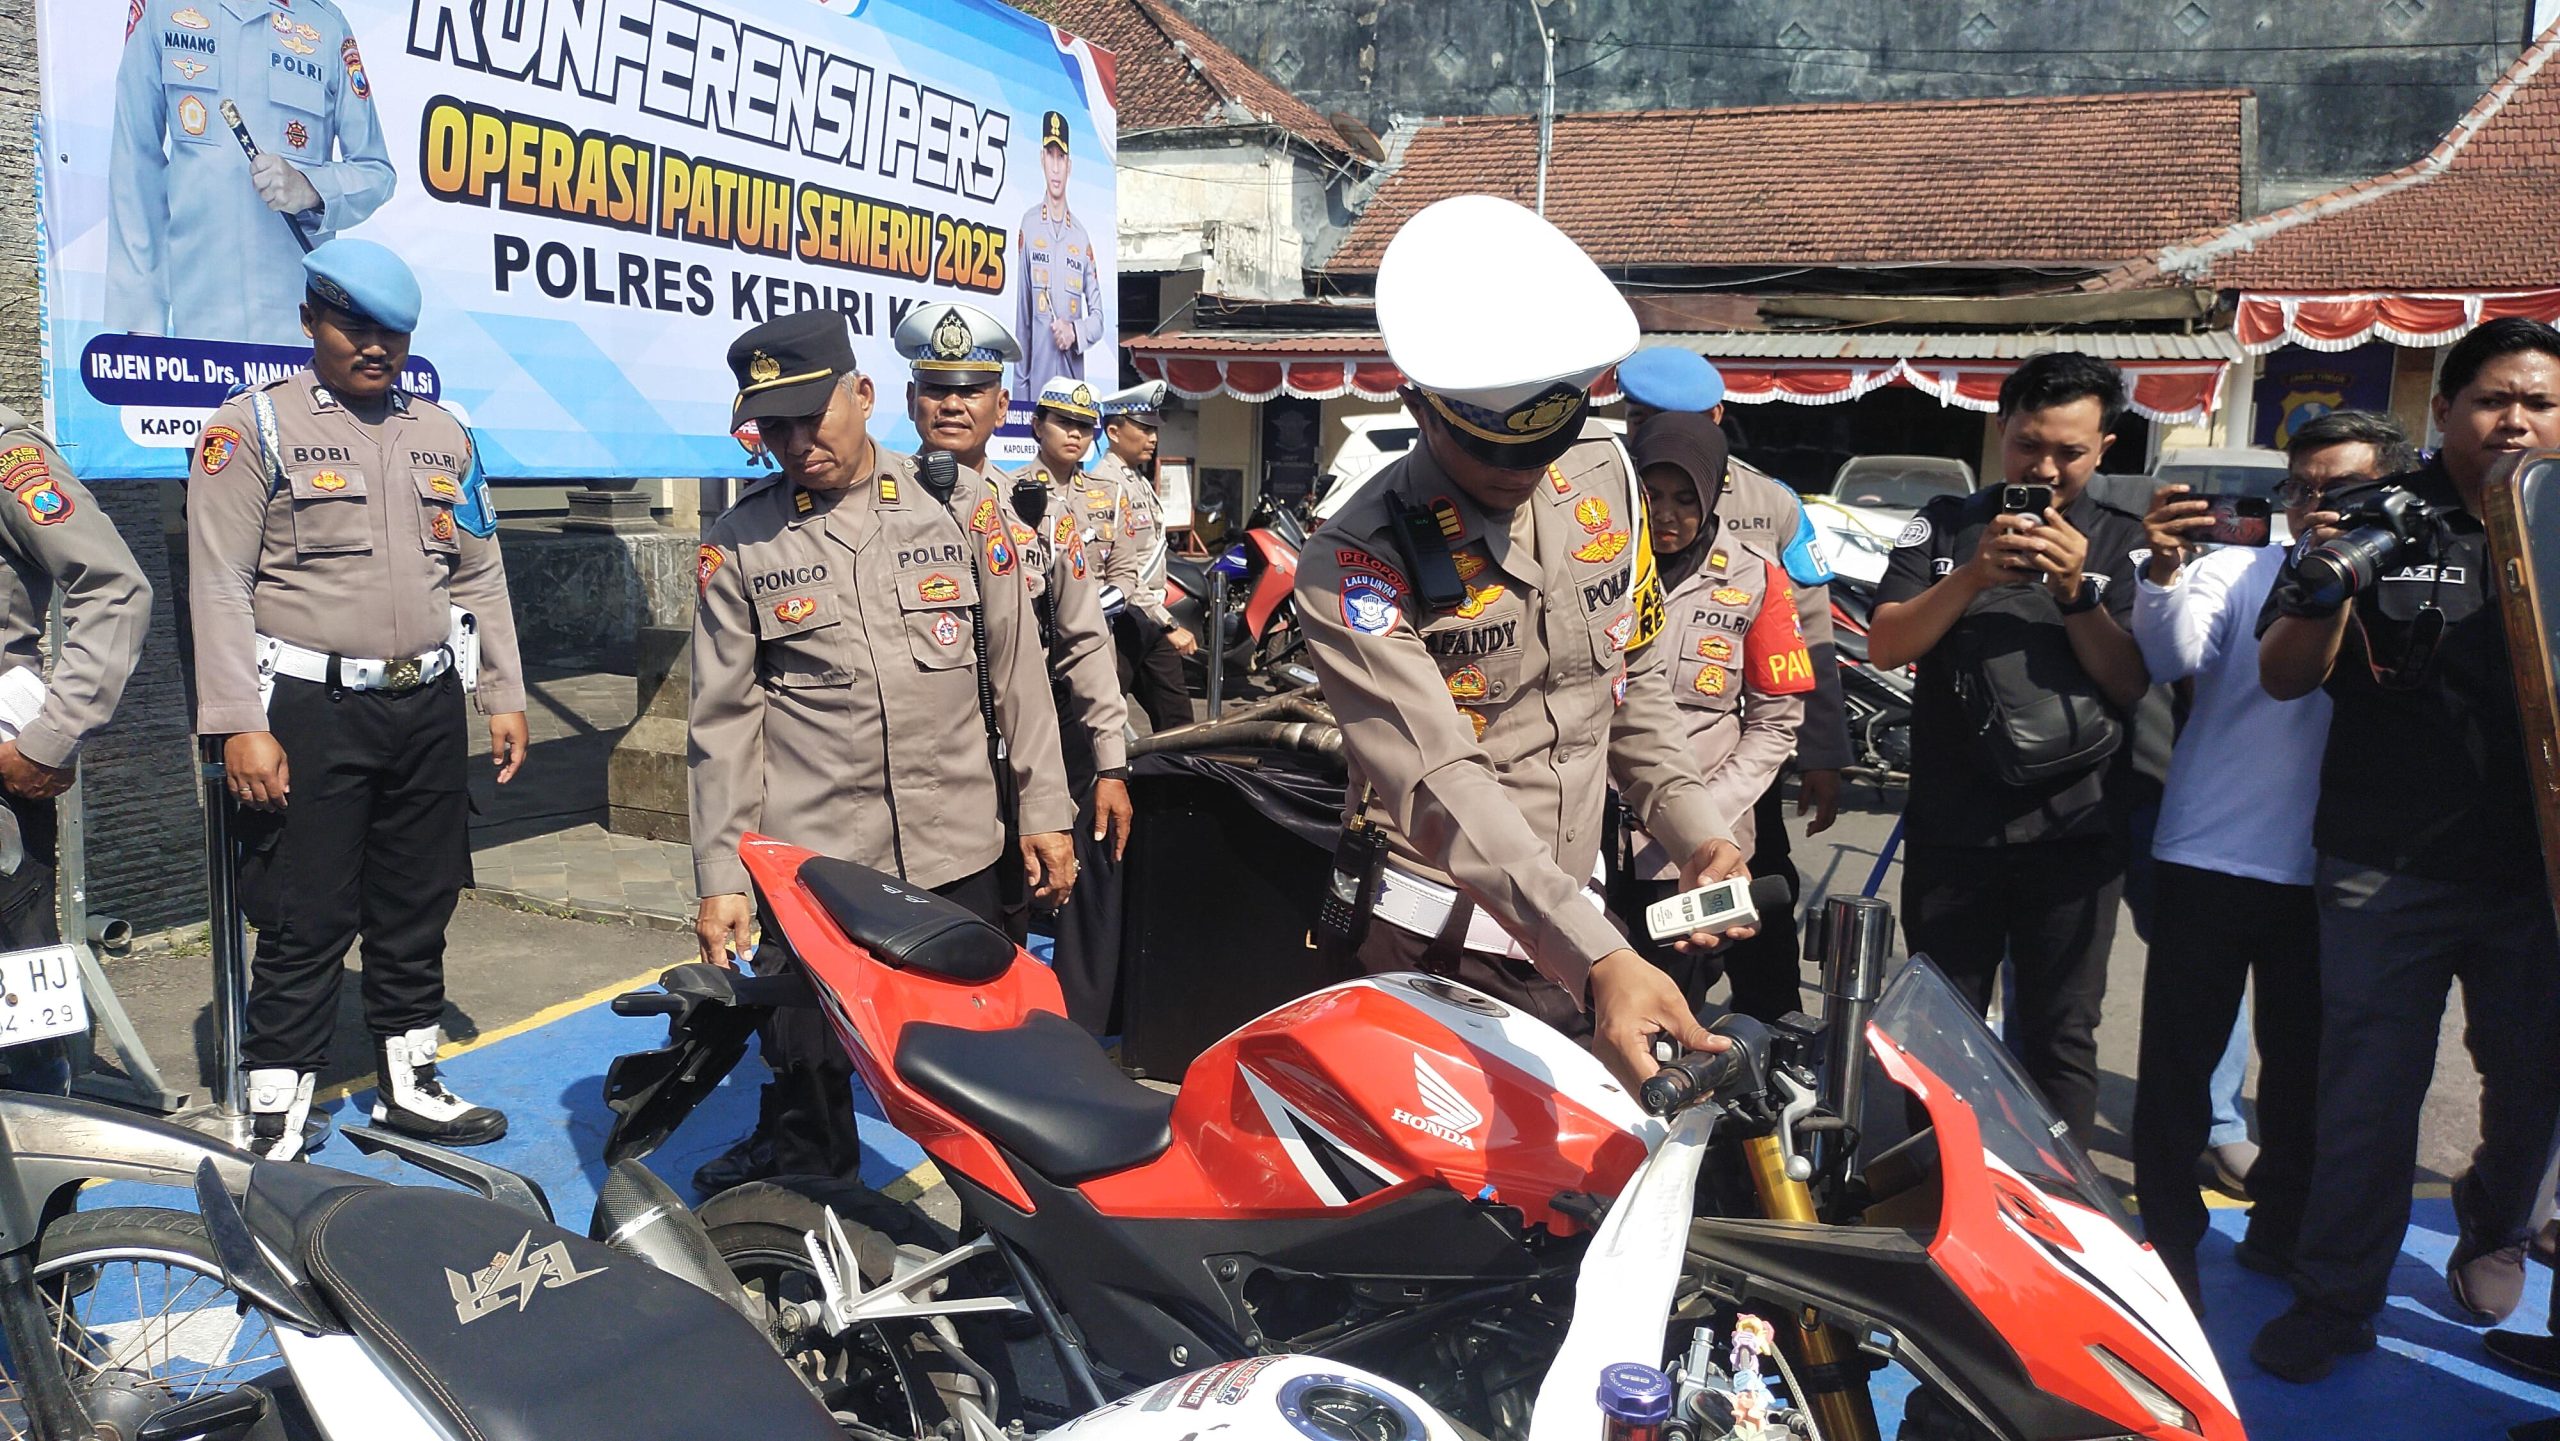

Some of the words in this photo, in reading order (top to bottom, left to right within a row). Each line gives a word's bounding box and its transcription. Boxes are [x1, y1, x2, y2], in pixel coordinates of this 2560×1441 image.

[165, 31, 216, 54] NANANG
[271, 52, 322, 82] POLRI
[881, 75, 1009, 202] PERS
[425, 103, 650, 228] OPERASI
[660, 154, 792, 253] PATUH
[799, 187, 931, 281] SEMERU
[935, 220, 1006, 296] 2025
[494, 233, 714, 316] POLRES
[1066, 257, 1083, 272] POLRI
[91, 353, 151, 380] IRJEN
[156, 357, 200, 384] POL.
[203, 360, 240, 386] Drs.
[244, 363, 306, 386] NANAN
[0, 447, 38, 466] OLRES
[293, 447, 351, 462] BOBI
[410, 451, 456, 469] POLRI
[1004, 444, 1036, 454] KAPOLRES
[1727, 516, 1772, 531] OLRI
[897, 544, 964, 569] POLRI
[752, 564, 829, 594] PONCO
[1345, 575, 1369, 588] LALU
[1369, 577, 1398, 599] LINTAS
[1692, 609, 1750, 636] POLRI
[28, 956, 68, 993] HJ
[1391, 1107, 1477, 1152] HONDA
